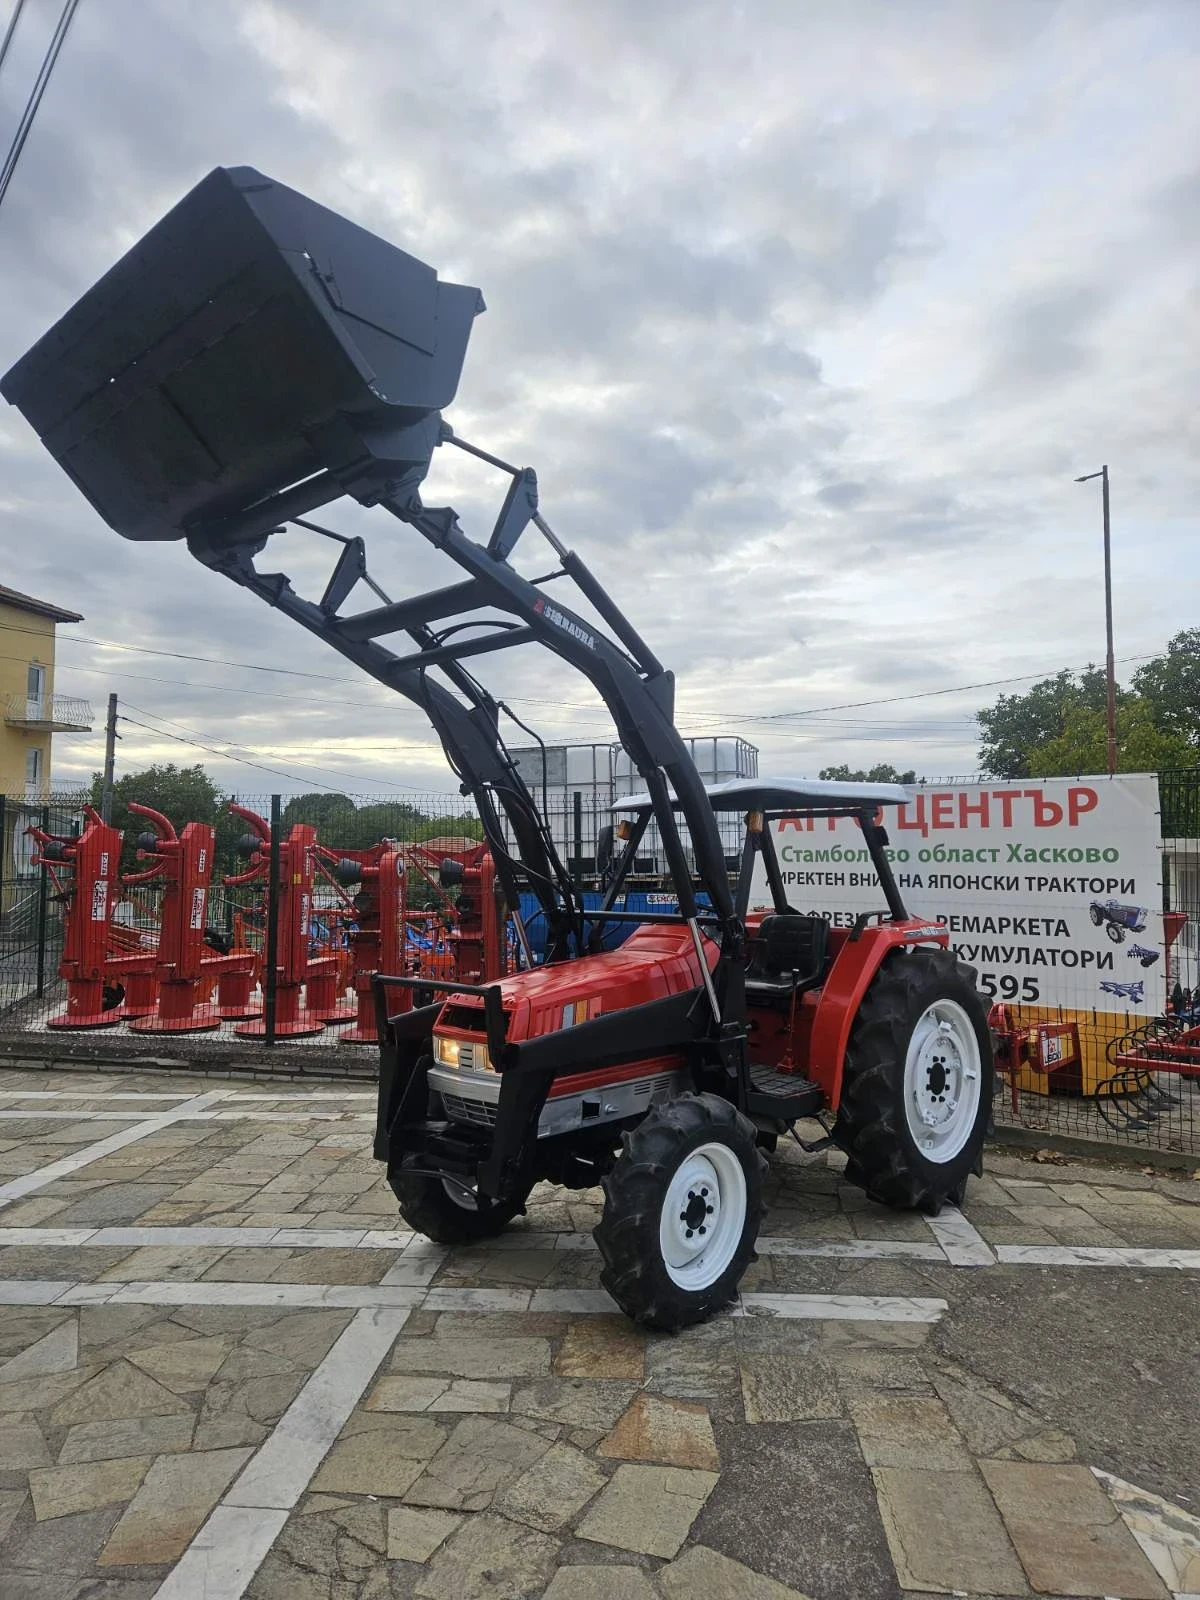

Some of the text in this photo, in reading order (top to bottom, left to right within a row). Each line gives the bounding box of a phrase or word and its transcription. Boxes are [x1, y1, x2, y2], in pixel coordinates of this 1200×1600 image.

[781, 843, 1120, 864] Стамболво област Хасково
[766, 871, 845, 886] ИРЕКТЕН
[899, 874, 923, 889] НА
[928, 875, 1019, 891] ЯПОНСКИ
[1025, 876, 1136, 895] ТРАКТОРИ
[936, 914, 1071, 938] РЕМАРКЕТА
[952, 943, 1114, 970] КУМУЛАТОРИ
